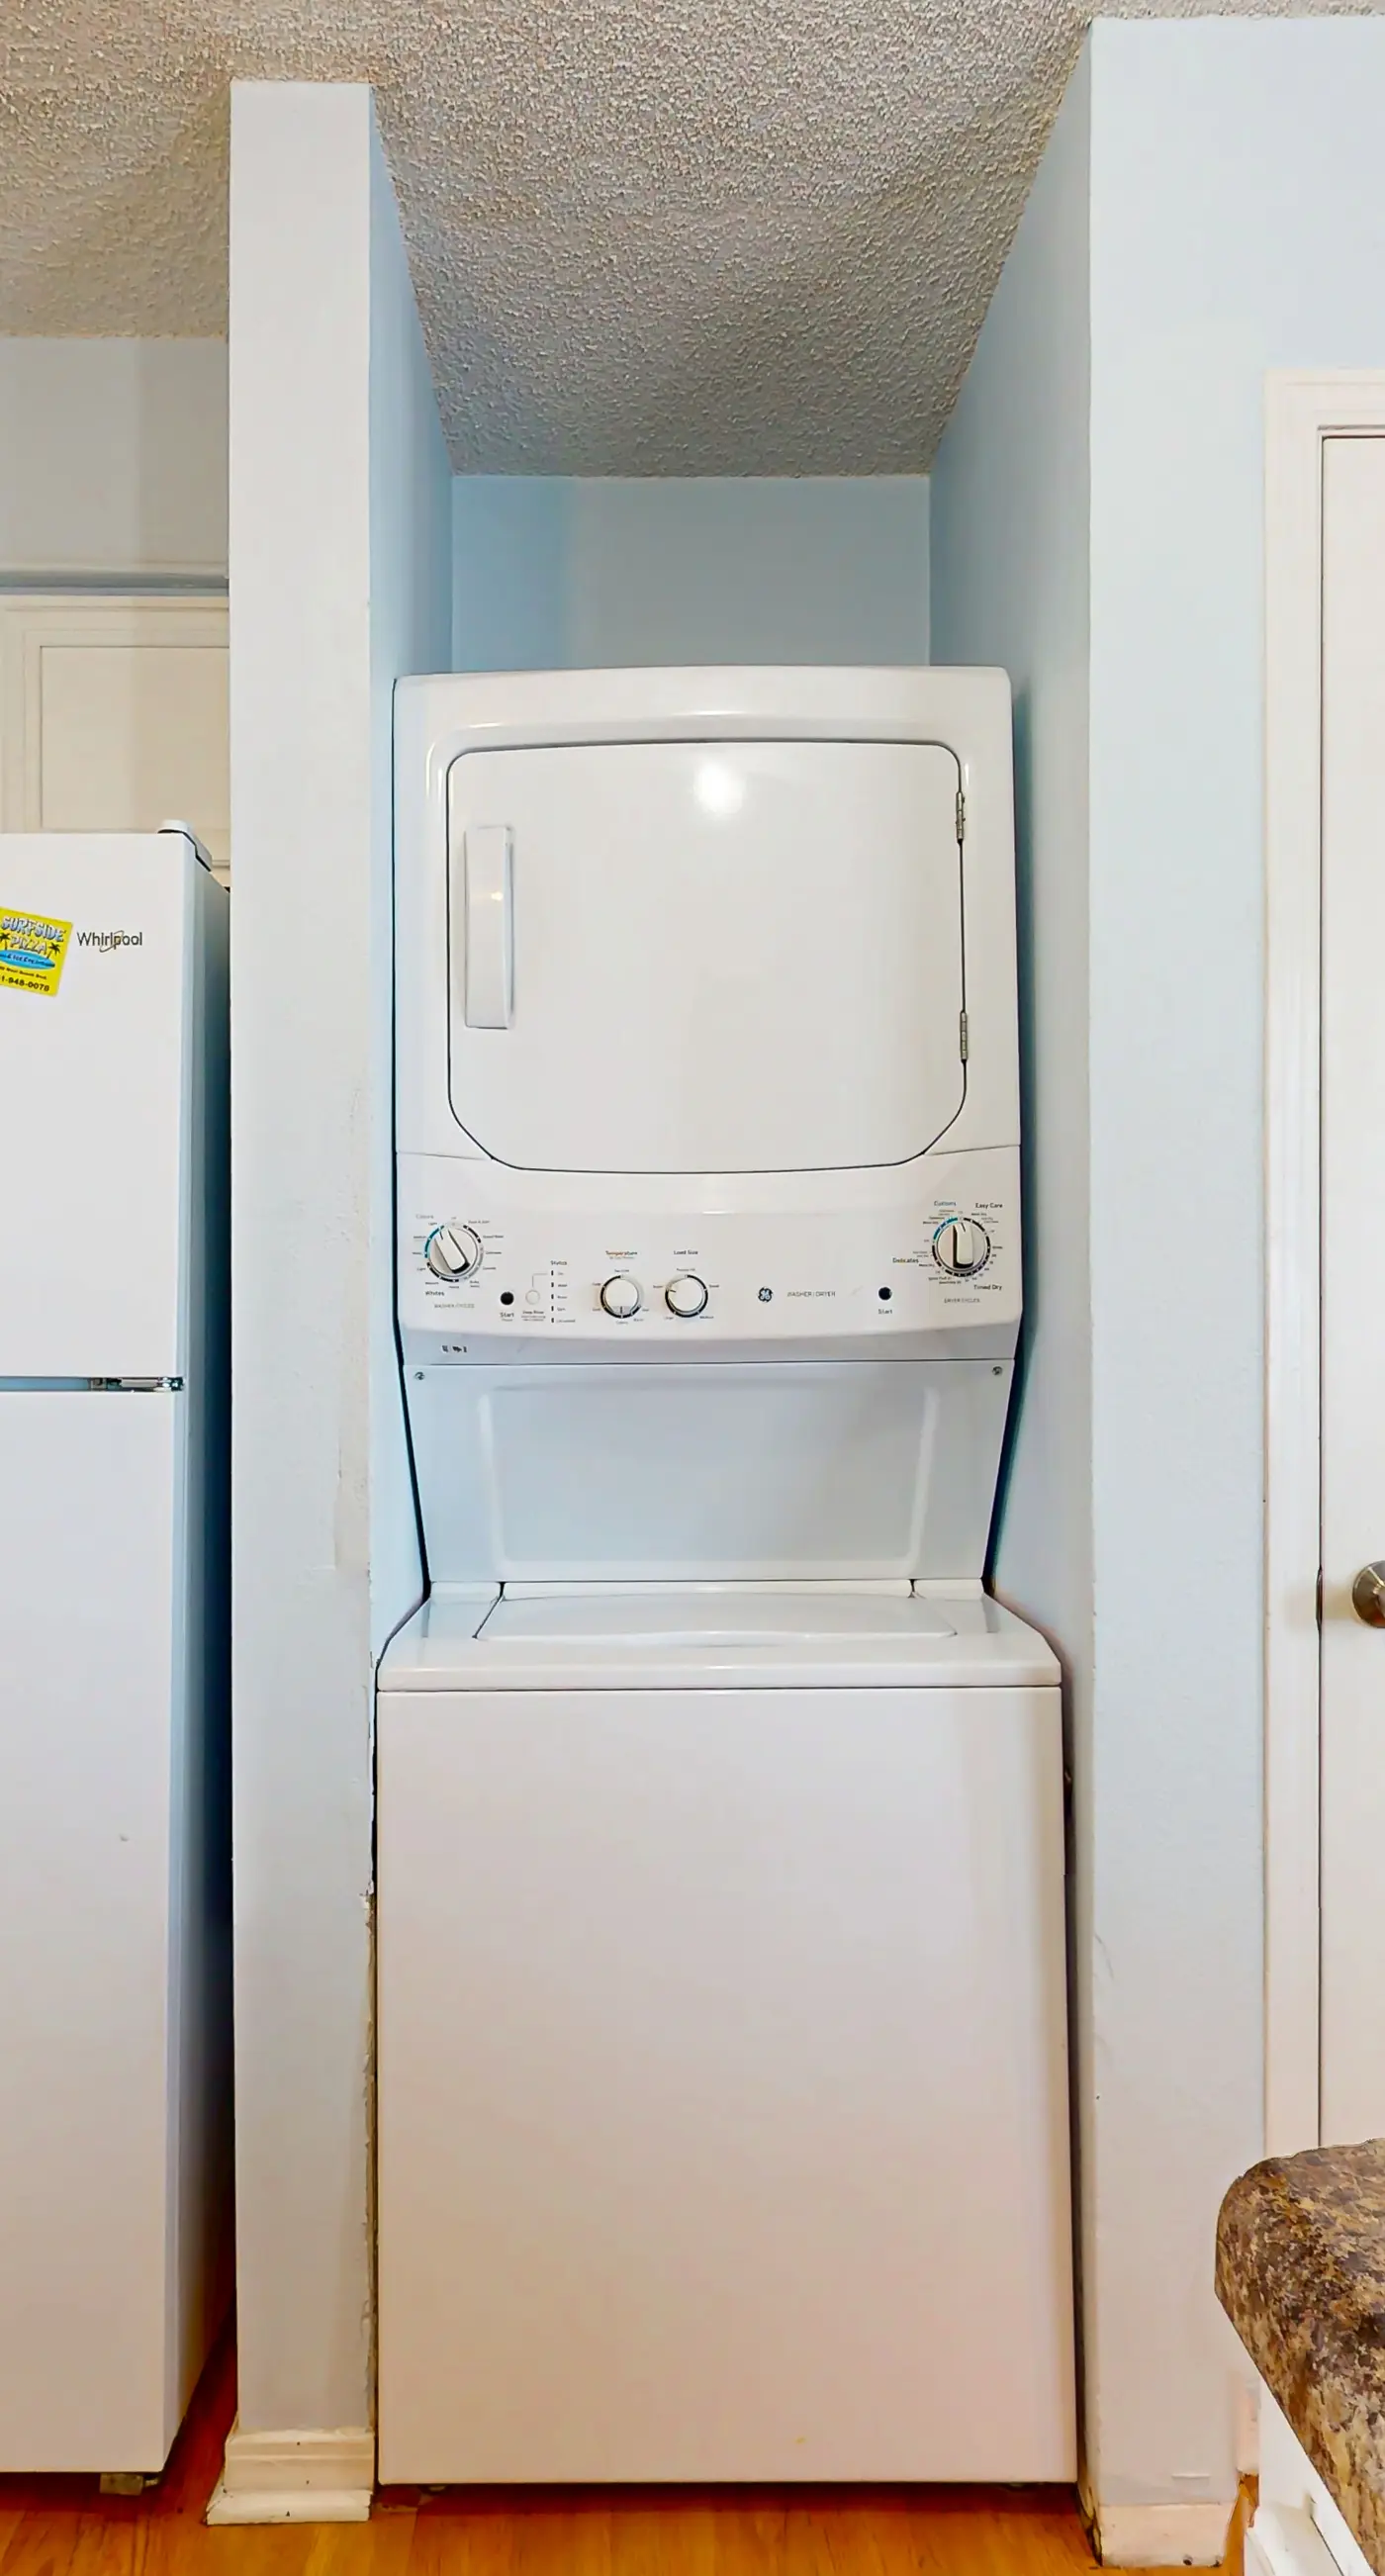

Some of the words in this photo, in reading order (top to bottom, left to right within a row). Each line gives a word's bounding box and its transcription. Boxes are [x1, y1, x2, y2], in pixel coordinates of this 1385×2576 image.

[1, 916, 66, 943] SURFSIDE
[10, 934, 48, 955] PIZZA
[76, 931, 143, 952] Whirlpool
